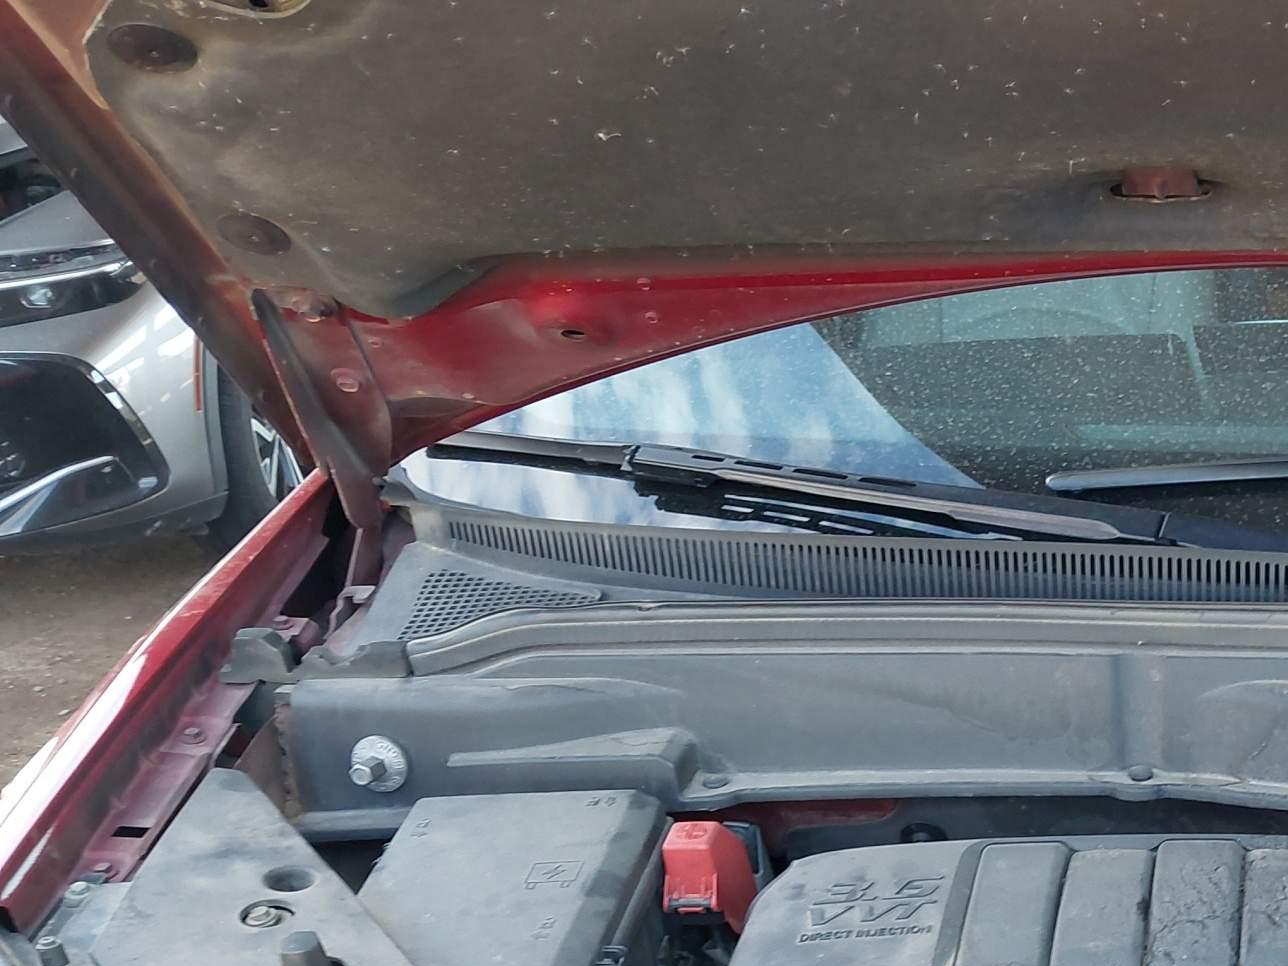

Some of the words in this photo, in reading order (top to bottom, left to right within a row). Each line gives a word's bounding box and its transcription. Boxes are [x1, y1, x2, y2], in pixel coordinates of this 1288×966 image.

[812, 875, 945, 906] 3.6
[806, 899, 939, 927] VVT
[797, 929, 852, 945] DIRECT
[854, 924, 934, 939] INJECTION
